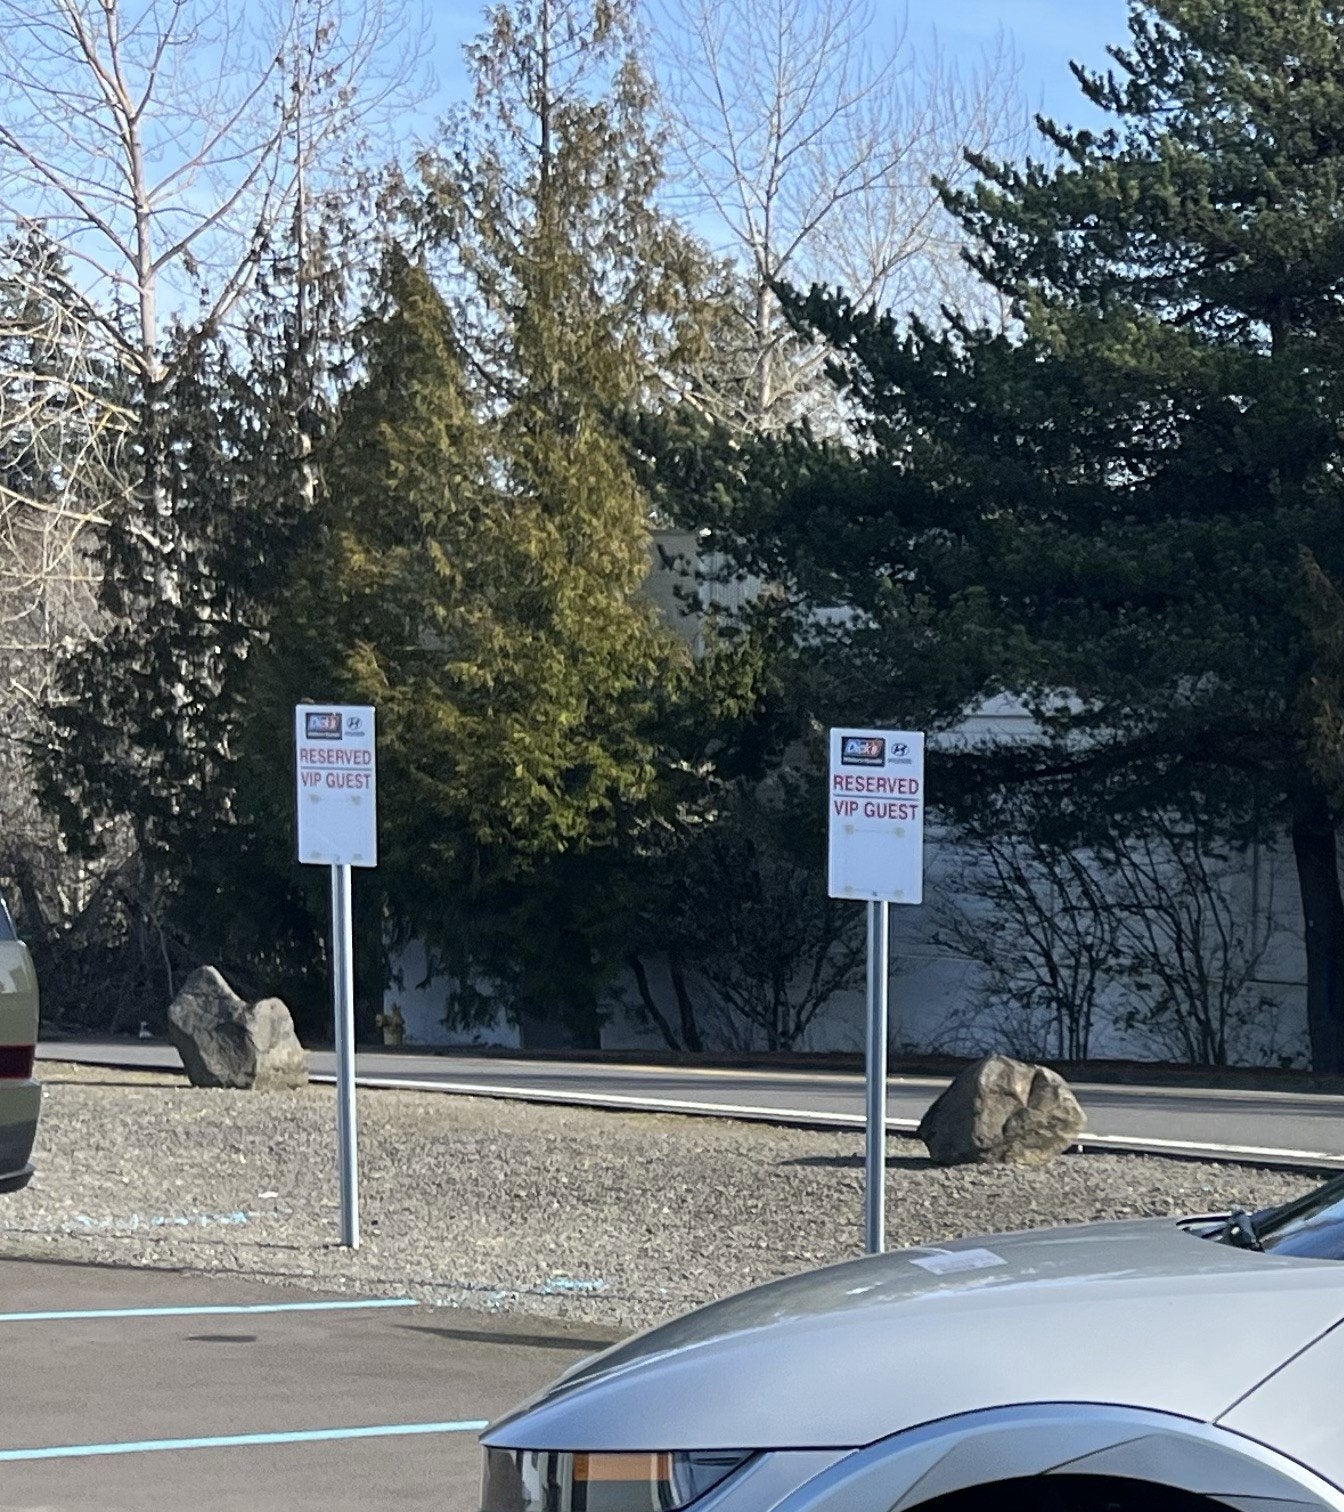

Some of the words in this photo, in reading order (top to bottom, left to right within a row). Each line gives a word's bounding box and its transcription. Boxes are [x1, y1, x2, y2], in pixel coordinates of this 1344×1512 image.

[300, 748, 372, 765] RESERVED
[301, 772, 322, 787] VIP
[326, 773, 371, 789] GUEST
[833, 774, 919, 795] RESERVED
[834, 800, 859, 816] VIP
[864, 801, 919, 820] GUEST
